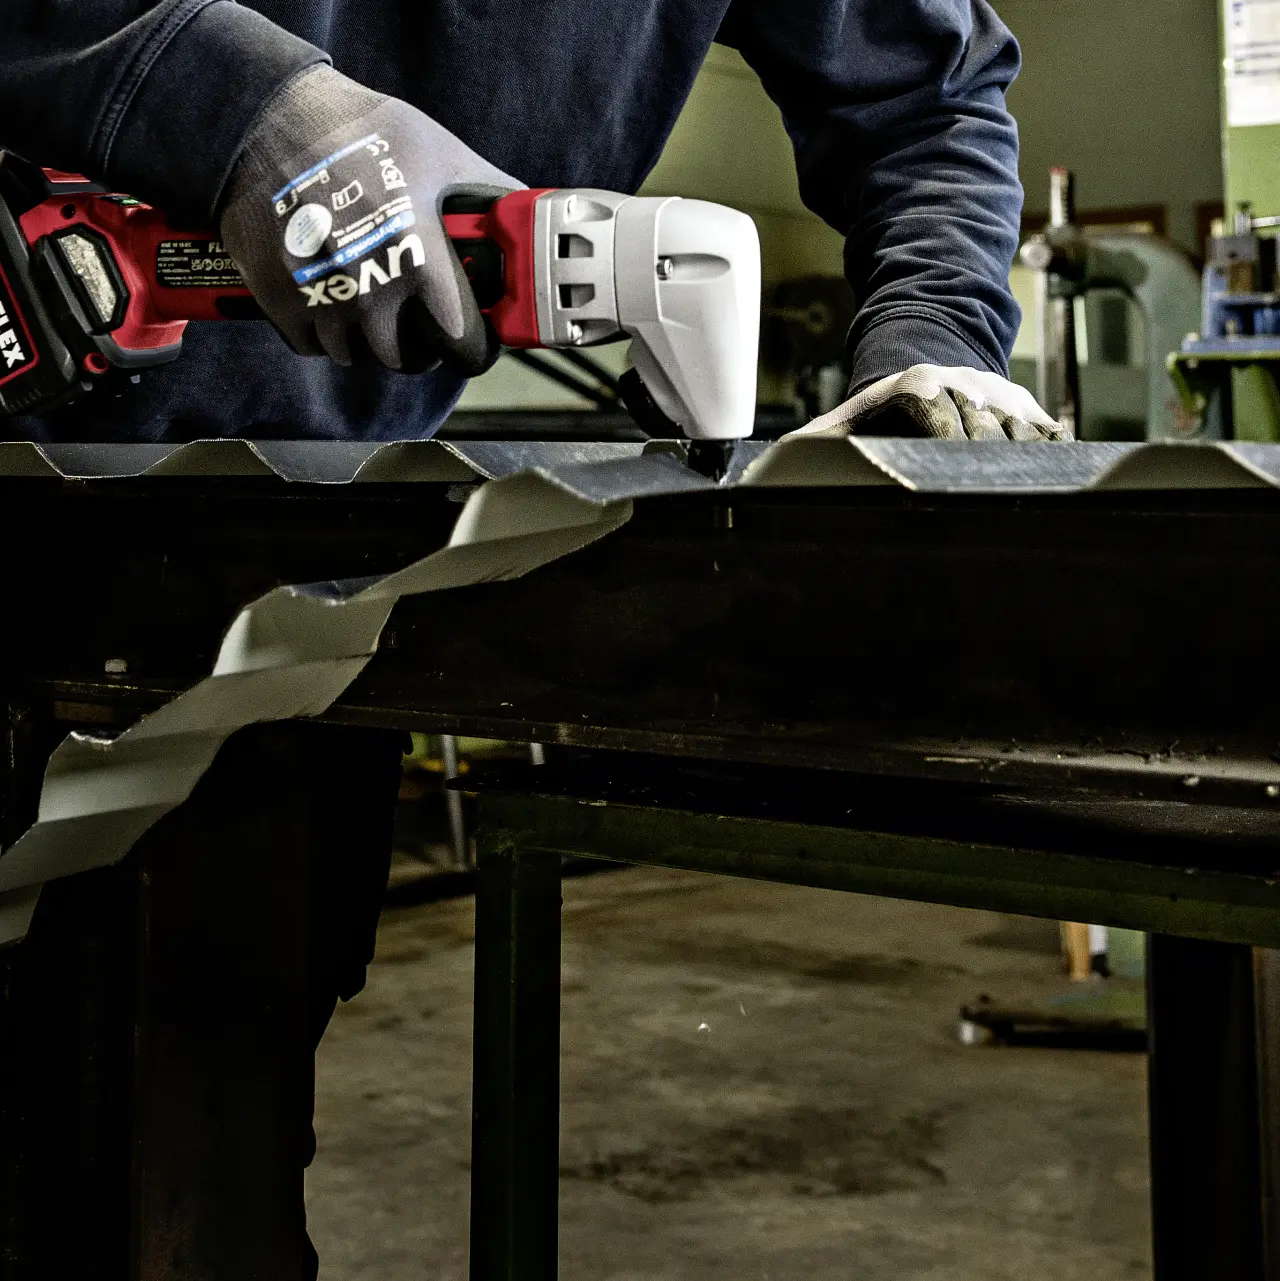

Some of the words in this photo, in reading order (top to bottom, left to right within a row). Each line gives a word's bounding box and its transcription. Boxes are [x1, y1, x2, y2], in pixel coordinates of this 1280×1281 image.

[208, 241, 226, 253] FL
[344, 216, 403, 259] phynomic
[297, 233, 426, 307] uvex
